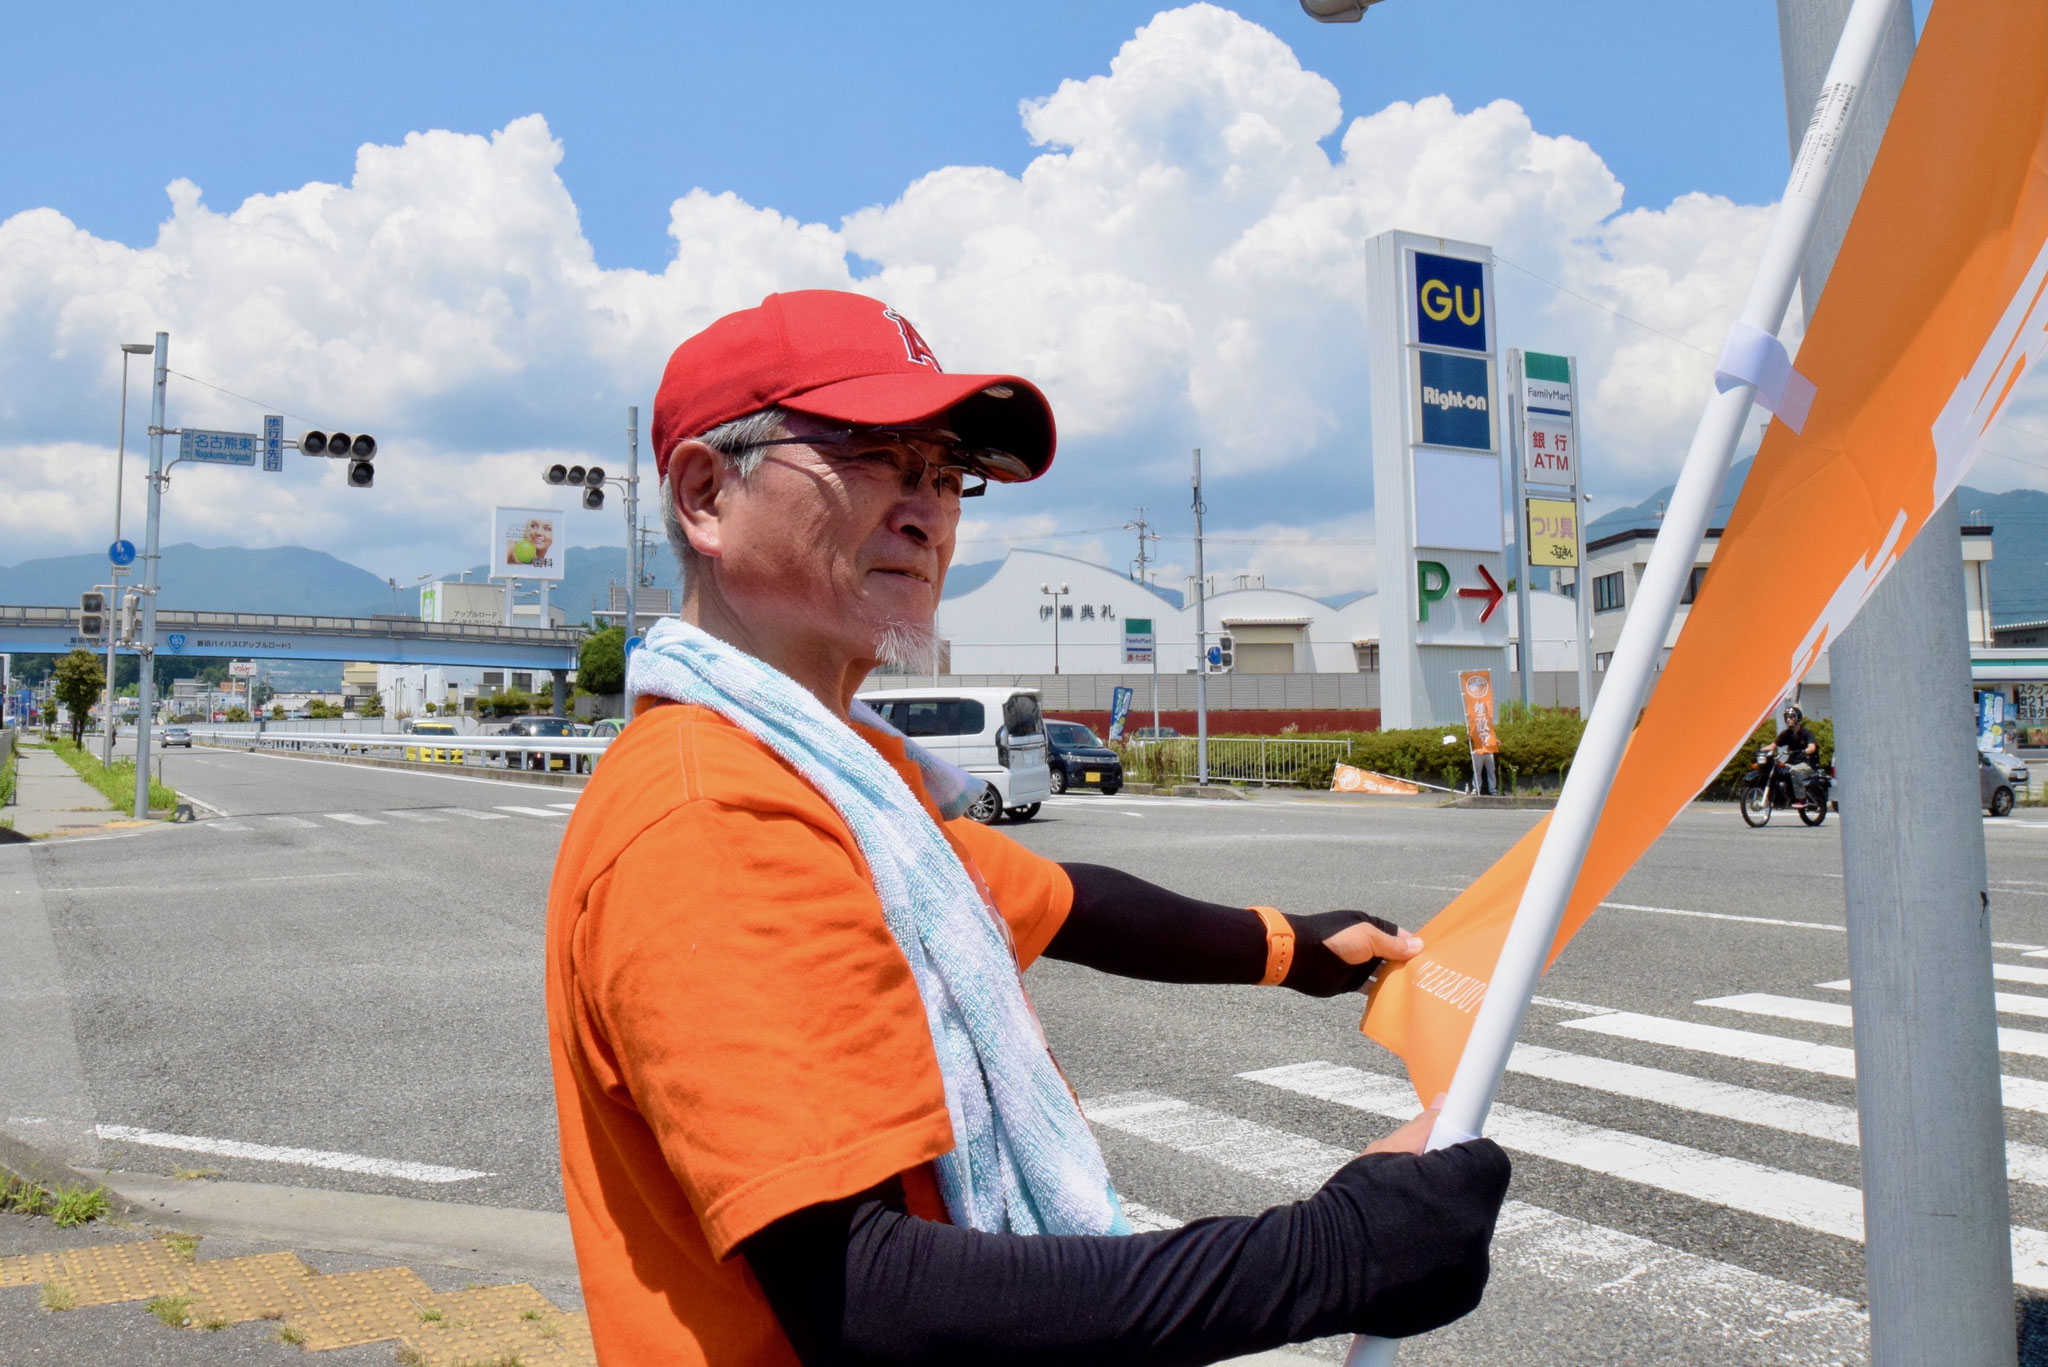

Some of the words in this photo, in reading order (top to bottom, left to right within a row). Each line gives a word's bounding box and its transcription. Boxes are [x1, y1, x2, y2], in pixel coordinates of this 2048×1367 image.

[1421, 279, 1481, 326] GU
[1423, 386, 1486, 411] Right-on
[1528, 387, 1570, 402] FamilyMart
[194, 434, 253, 452] 名古熊東
[268, 418, 280, 470] 歩行者先行
[1532, 431, 1567, 452] 銀行
[1534, 453, 1569, 471] ATM
[1531, 517, 1575, 539] つり具
[1416, 560, 1450, 622] P
[454, 610, 498, 618] アップルロード
[1040, 604, 1116, 620] 伊藤典礼
[1126, 637, 1152, 646] FamilyMart
